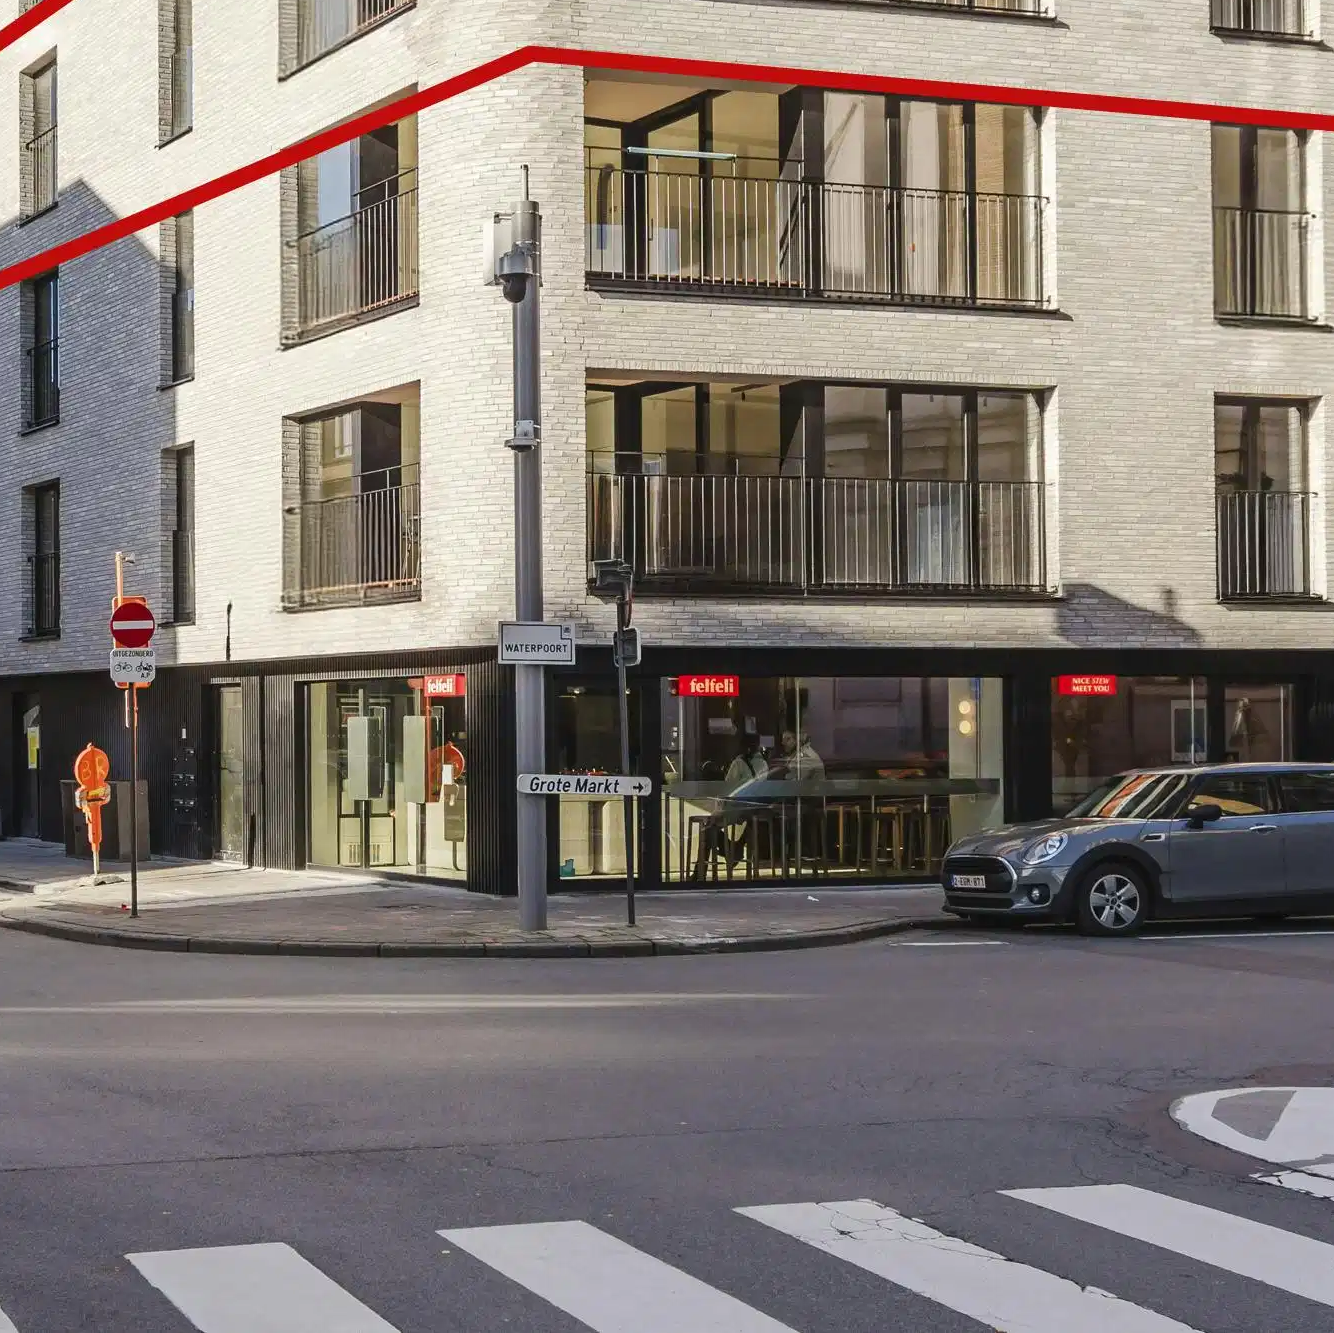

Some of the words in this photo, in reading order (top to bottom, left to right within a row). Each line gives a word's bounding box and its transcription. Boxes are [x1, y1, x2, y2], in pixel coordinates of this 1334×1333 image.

[505, 643, 568, 654] WATERPOORT
[427, 677, 453, 694] felfeli
[689, 678, 734, 693] felfeli
[529, 776, 571, 793] Grote
[575, 777, 620, 794] Markt
